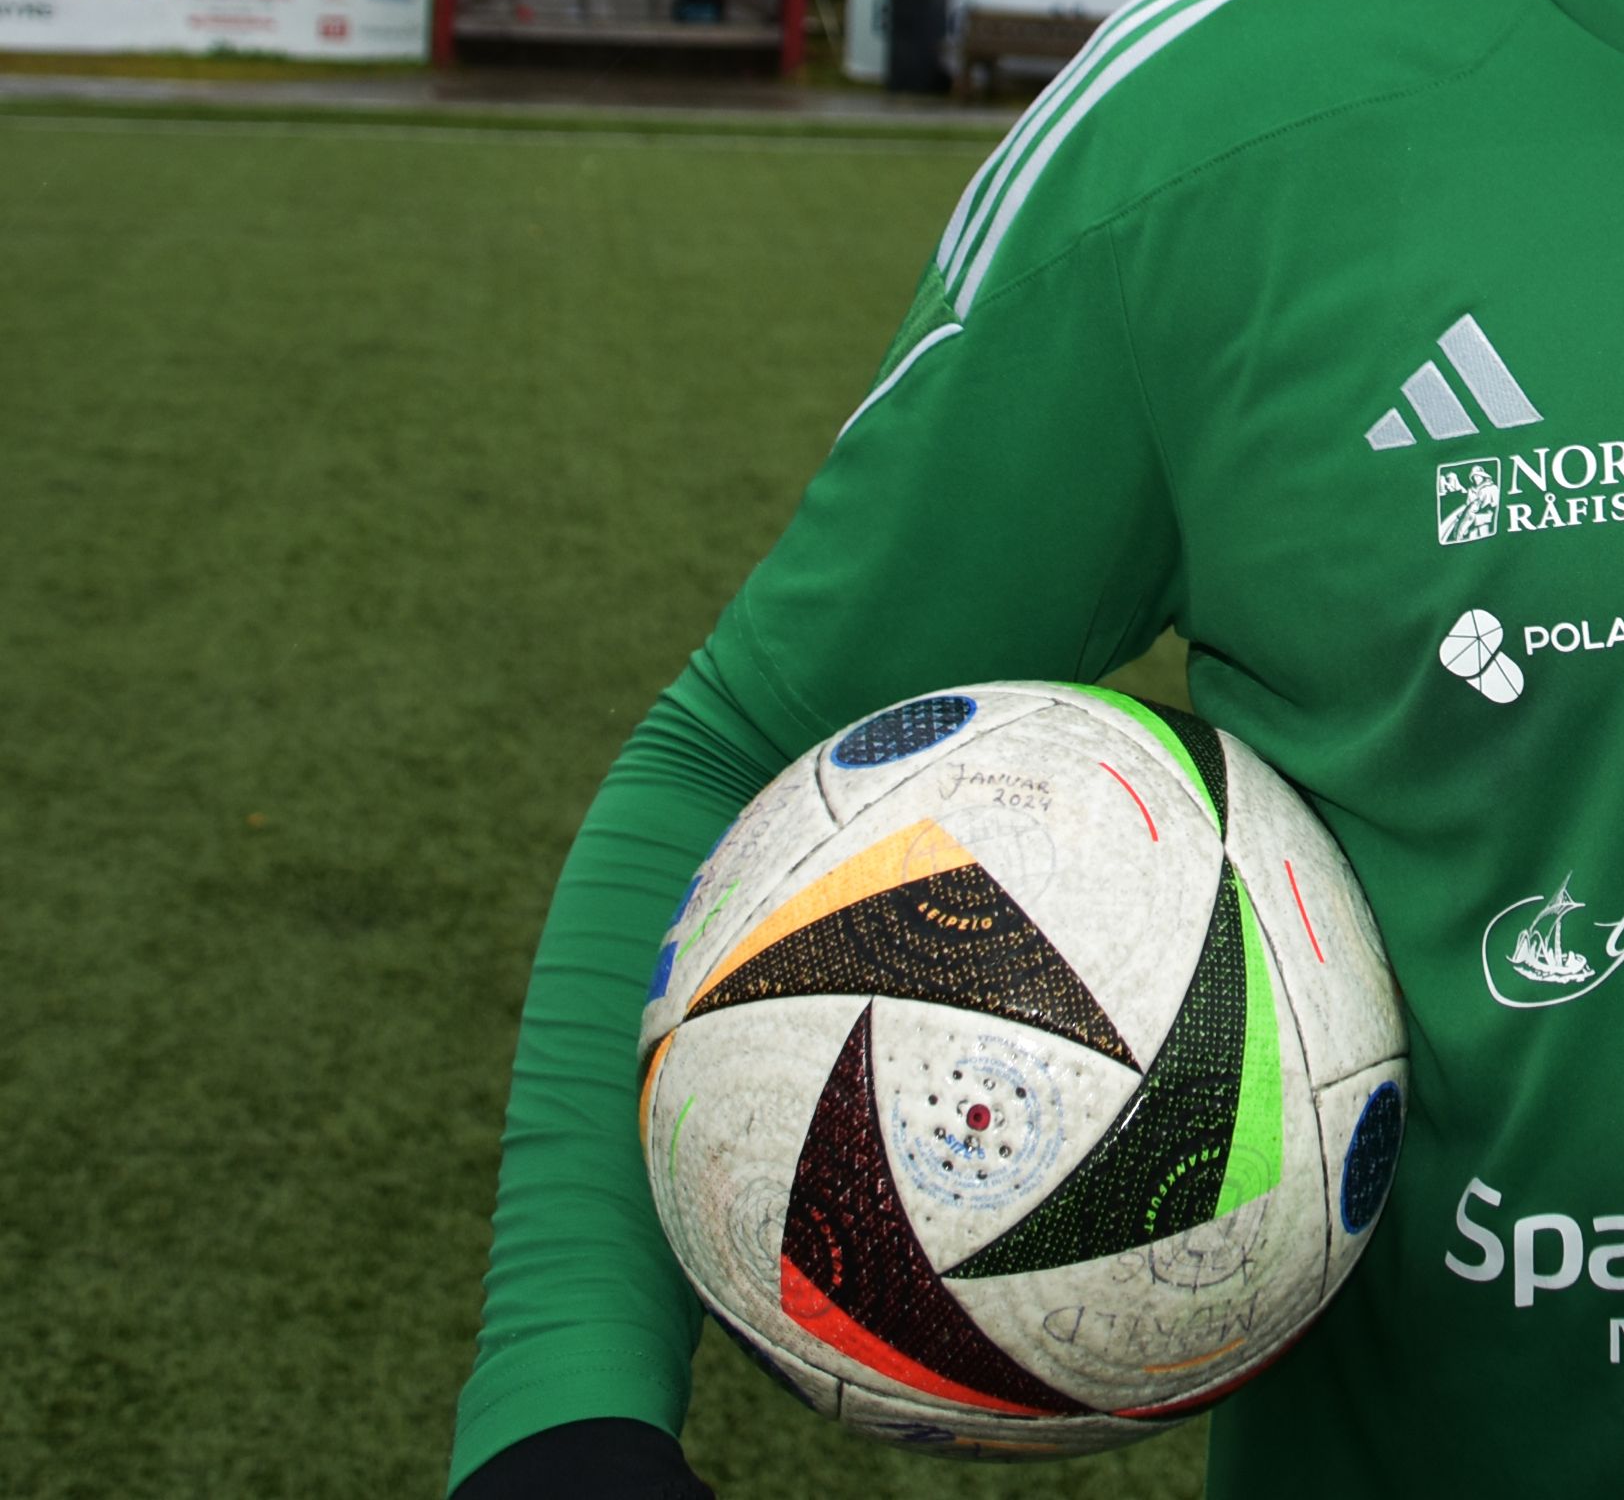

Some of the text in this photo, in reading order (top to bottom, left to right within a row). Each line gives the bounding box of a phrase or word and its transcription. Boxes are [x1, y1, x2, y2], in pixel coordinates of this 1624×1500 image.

[993, 788, 1053, 812] 2024
[917, 901, 993, 932] LEIPZIG
[1144, 1146, 1221, 1235] FRANKFURT
